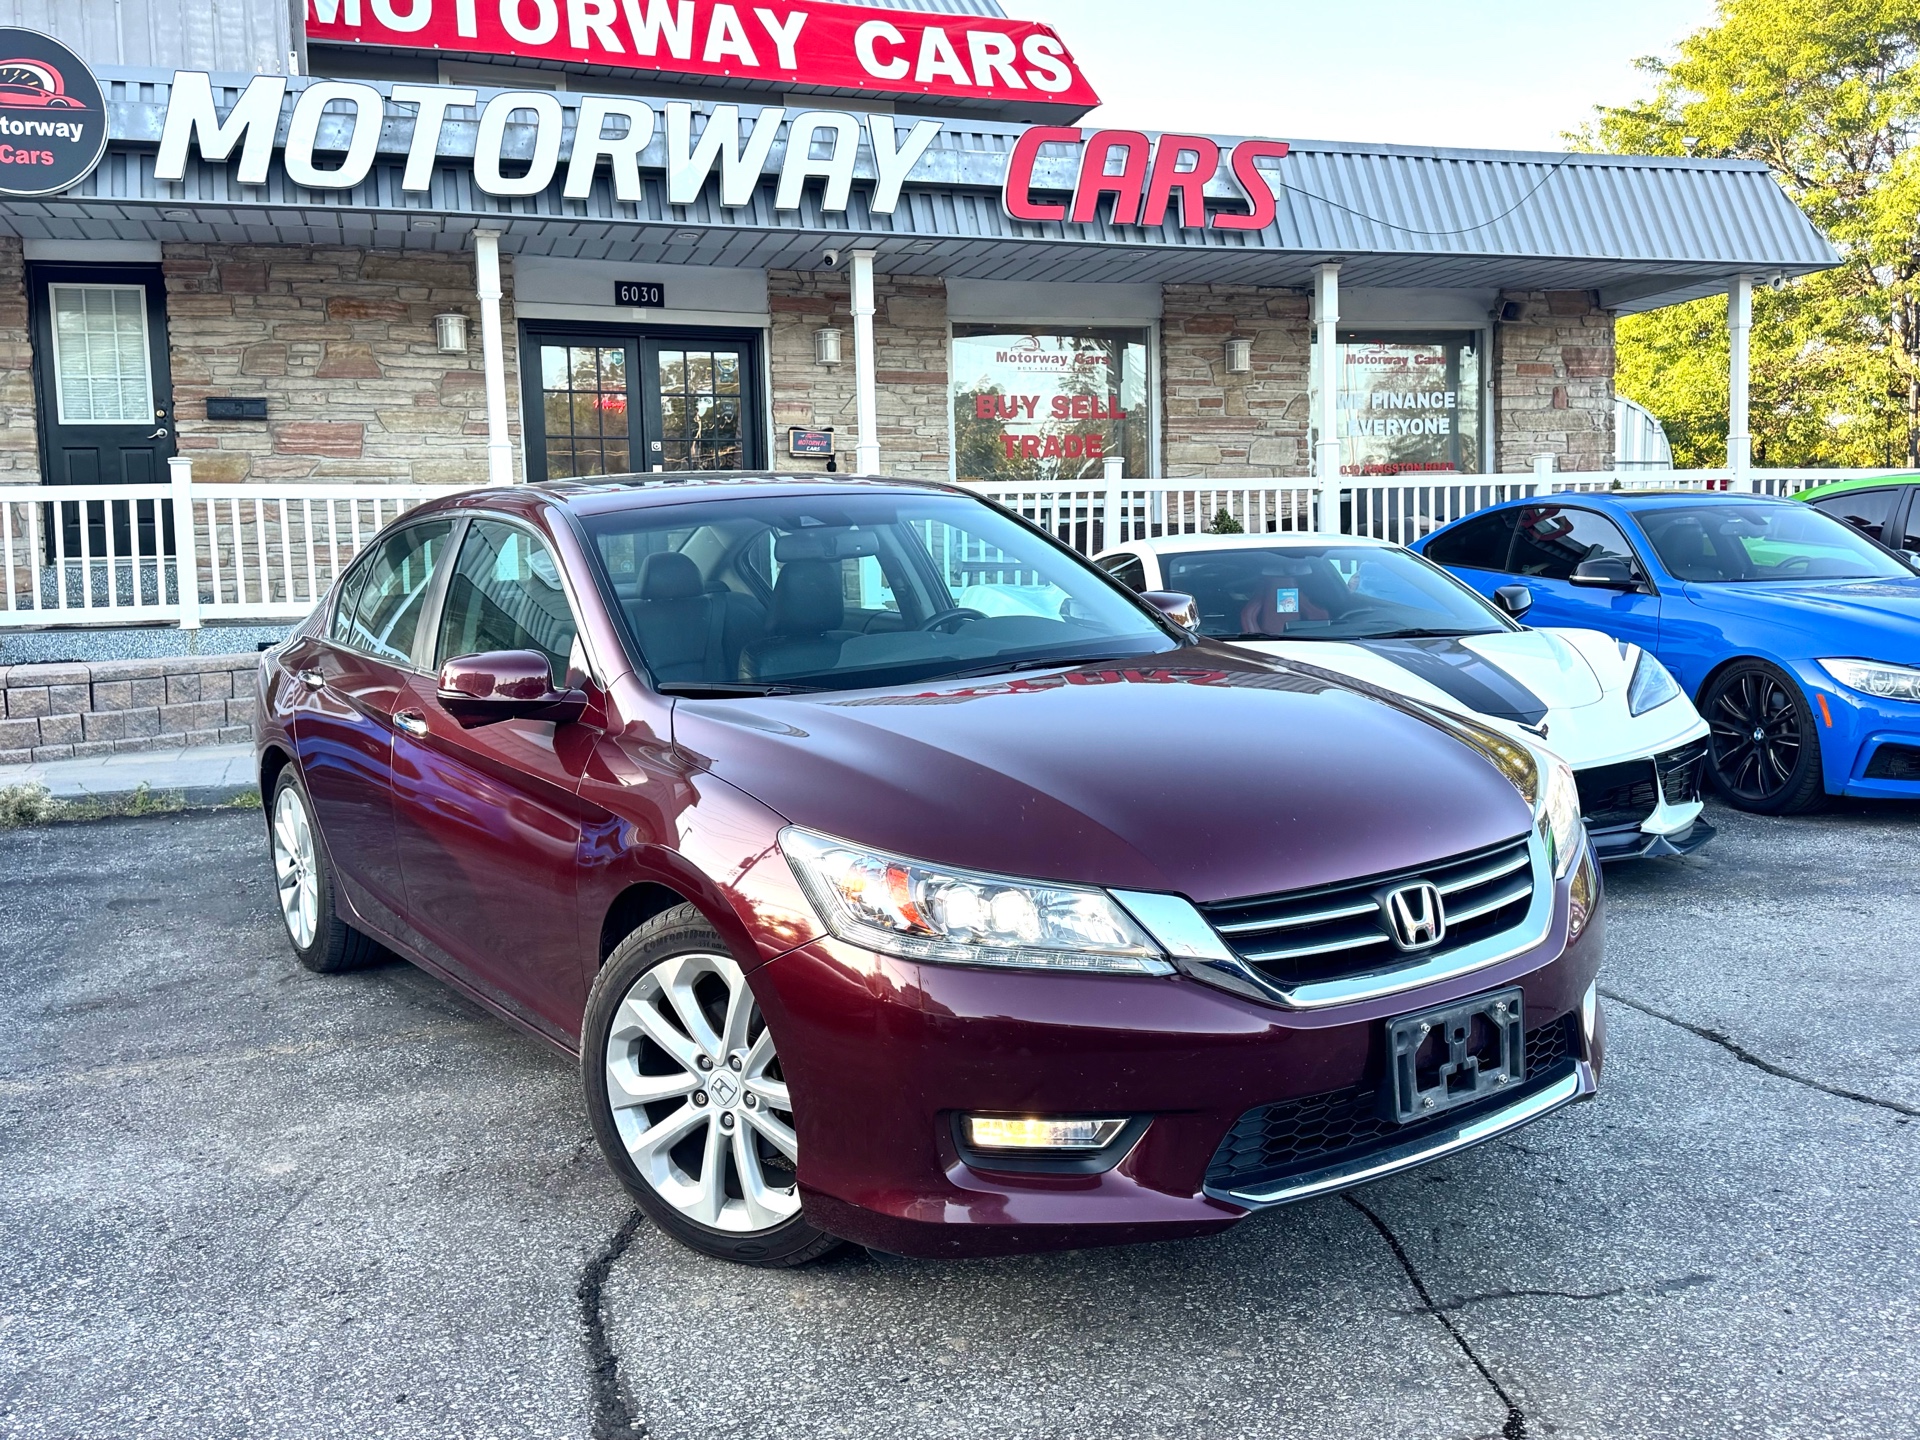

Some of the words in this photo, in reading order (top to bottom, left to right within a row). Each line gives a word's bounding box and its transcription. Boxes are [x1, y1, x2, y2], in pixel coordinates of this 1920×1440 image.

[854, 20, 1073, 94] CARS
[0, 144, 55, 166] Cars
[153, 70, 944, 214] MOTORWAY
[1002, 125, 1290, 231] CARS
[621, 285, 659, 303] 6030
[996, 351, 1068, 366] Motorway
[1075, 352, 1111, 365] Cars
[1345, 353, 1409, 366] Motorway
[1414, 353, 1447, 365] Cars
[976, 395, 1040, 419] BUY
[1051, 396, 1126, 420] SELL
[1371, 391, 1456, 409] FINANCE
[1347, 417, 1451, 436] EVERYONE
[999, 434, 1104, 459] TRADE
